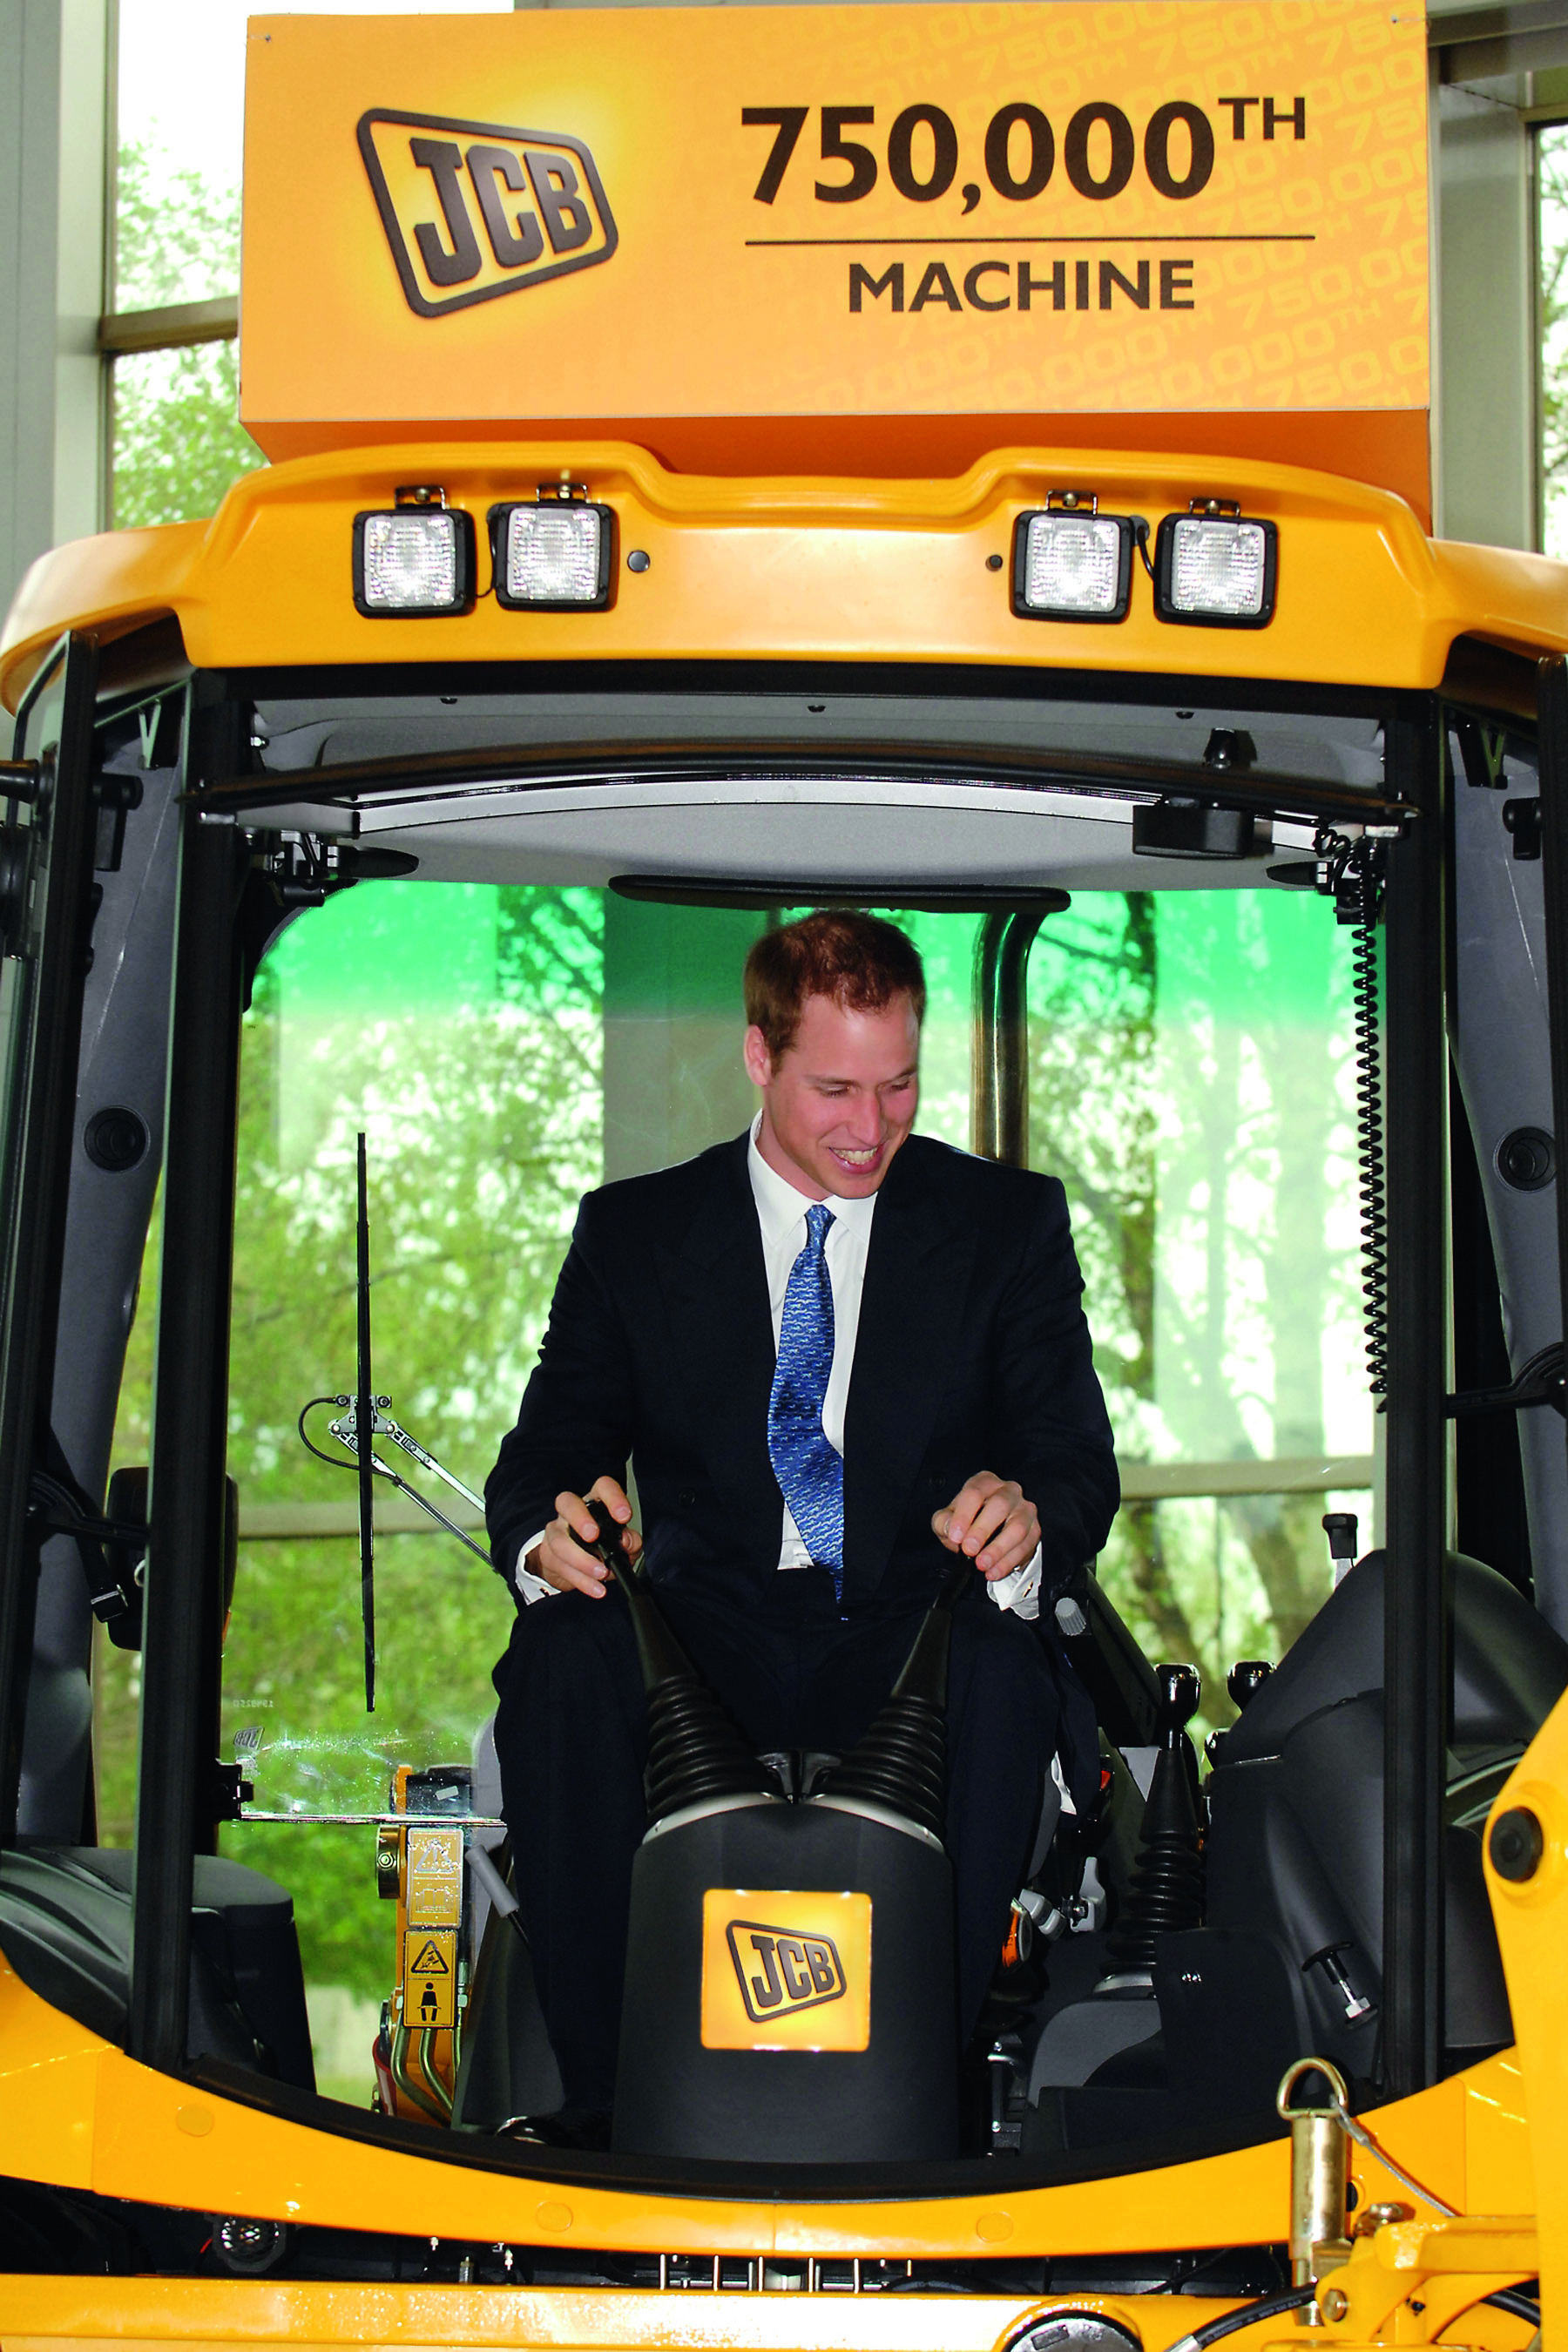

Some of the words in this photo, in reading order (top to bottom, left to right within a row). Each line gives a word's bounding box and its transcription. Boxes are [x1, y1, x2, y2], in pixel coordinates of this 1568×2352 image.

[409, 137, 593, 287] JCB
[848, 259, 1195, 314] MACHINE
[750, 1934, 835, 2008] JCB
